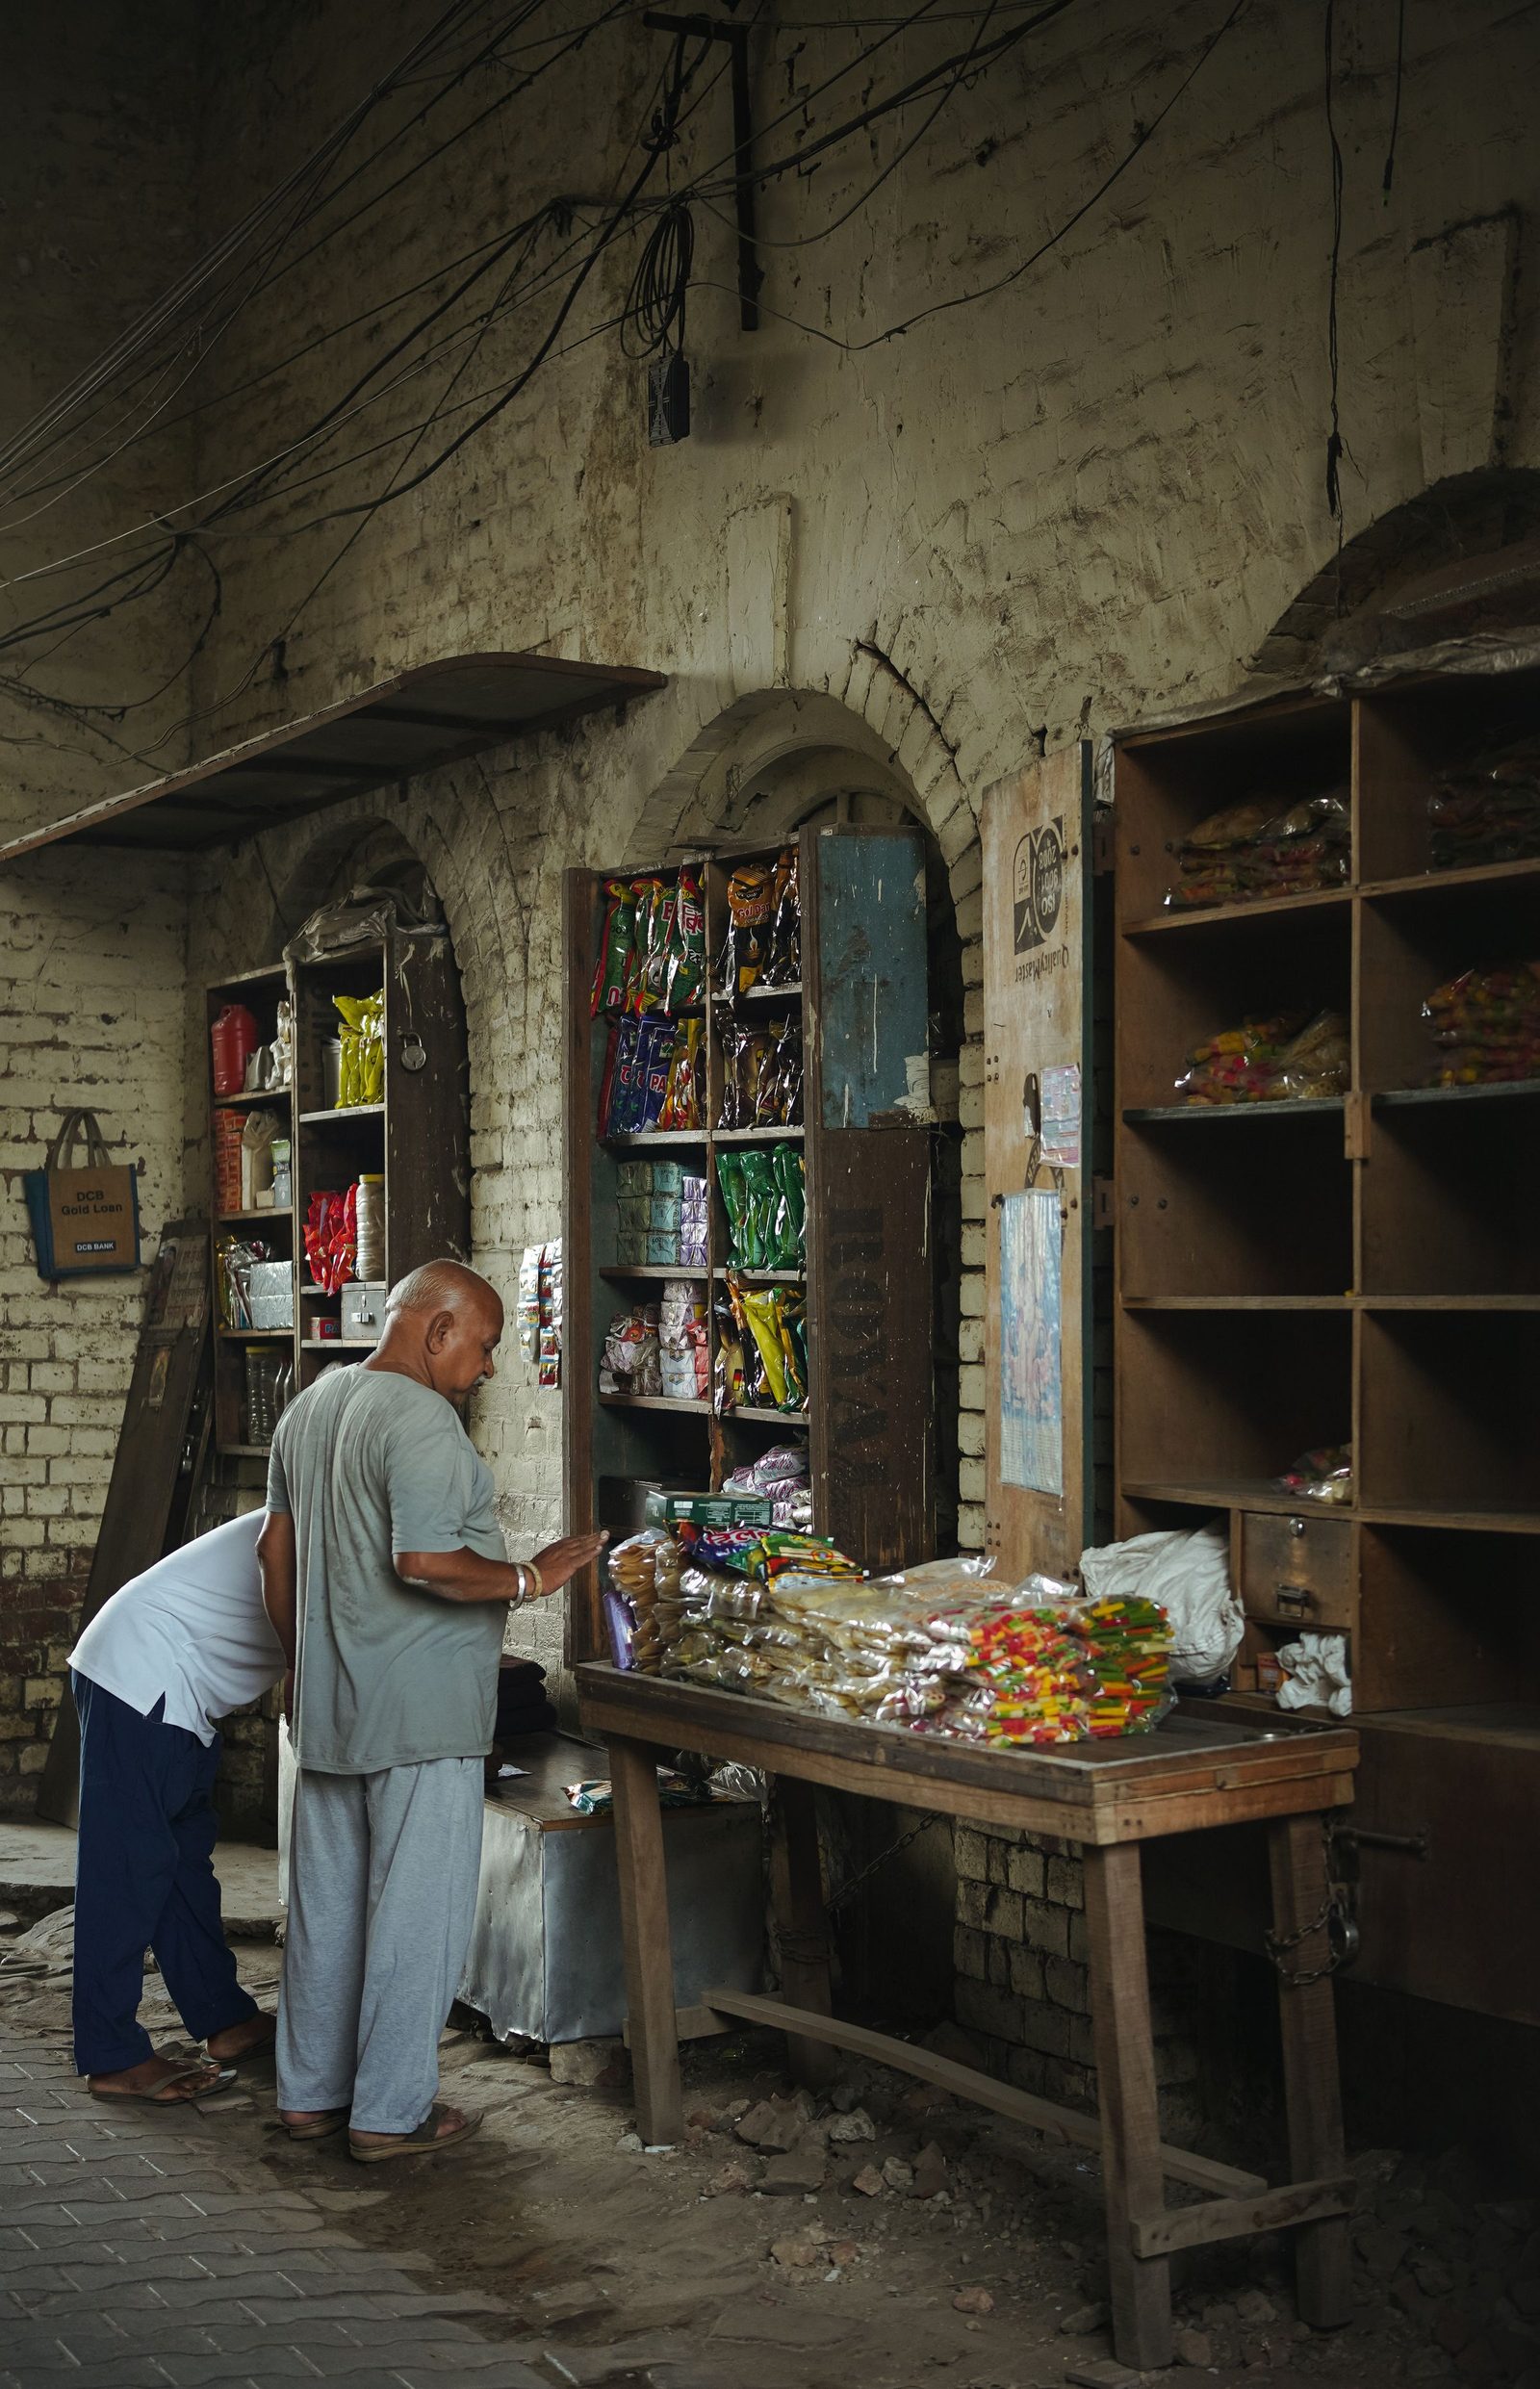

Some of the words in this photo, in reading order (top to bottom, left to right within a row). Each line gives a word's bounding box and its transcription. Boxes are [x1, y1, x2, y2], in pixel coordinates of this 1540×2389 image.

[1041, 894, 1056, 917] ISO
[77, 1190, 104, 1202] DCB
[62, 1205, 90, 1216] Gold
[93, 1202, 122, 1213] Loan
[93, 1242, 115, 1250] BANK
